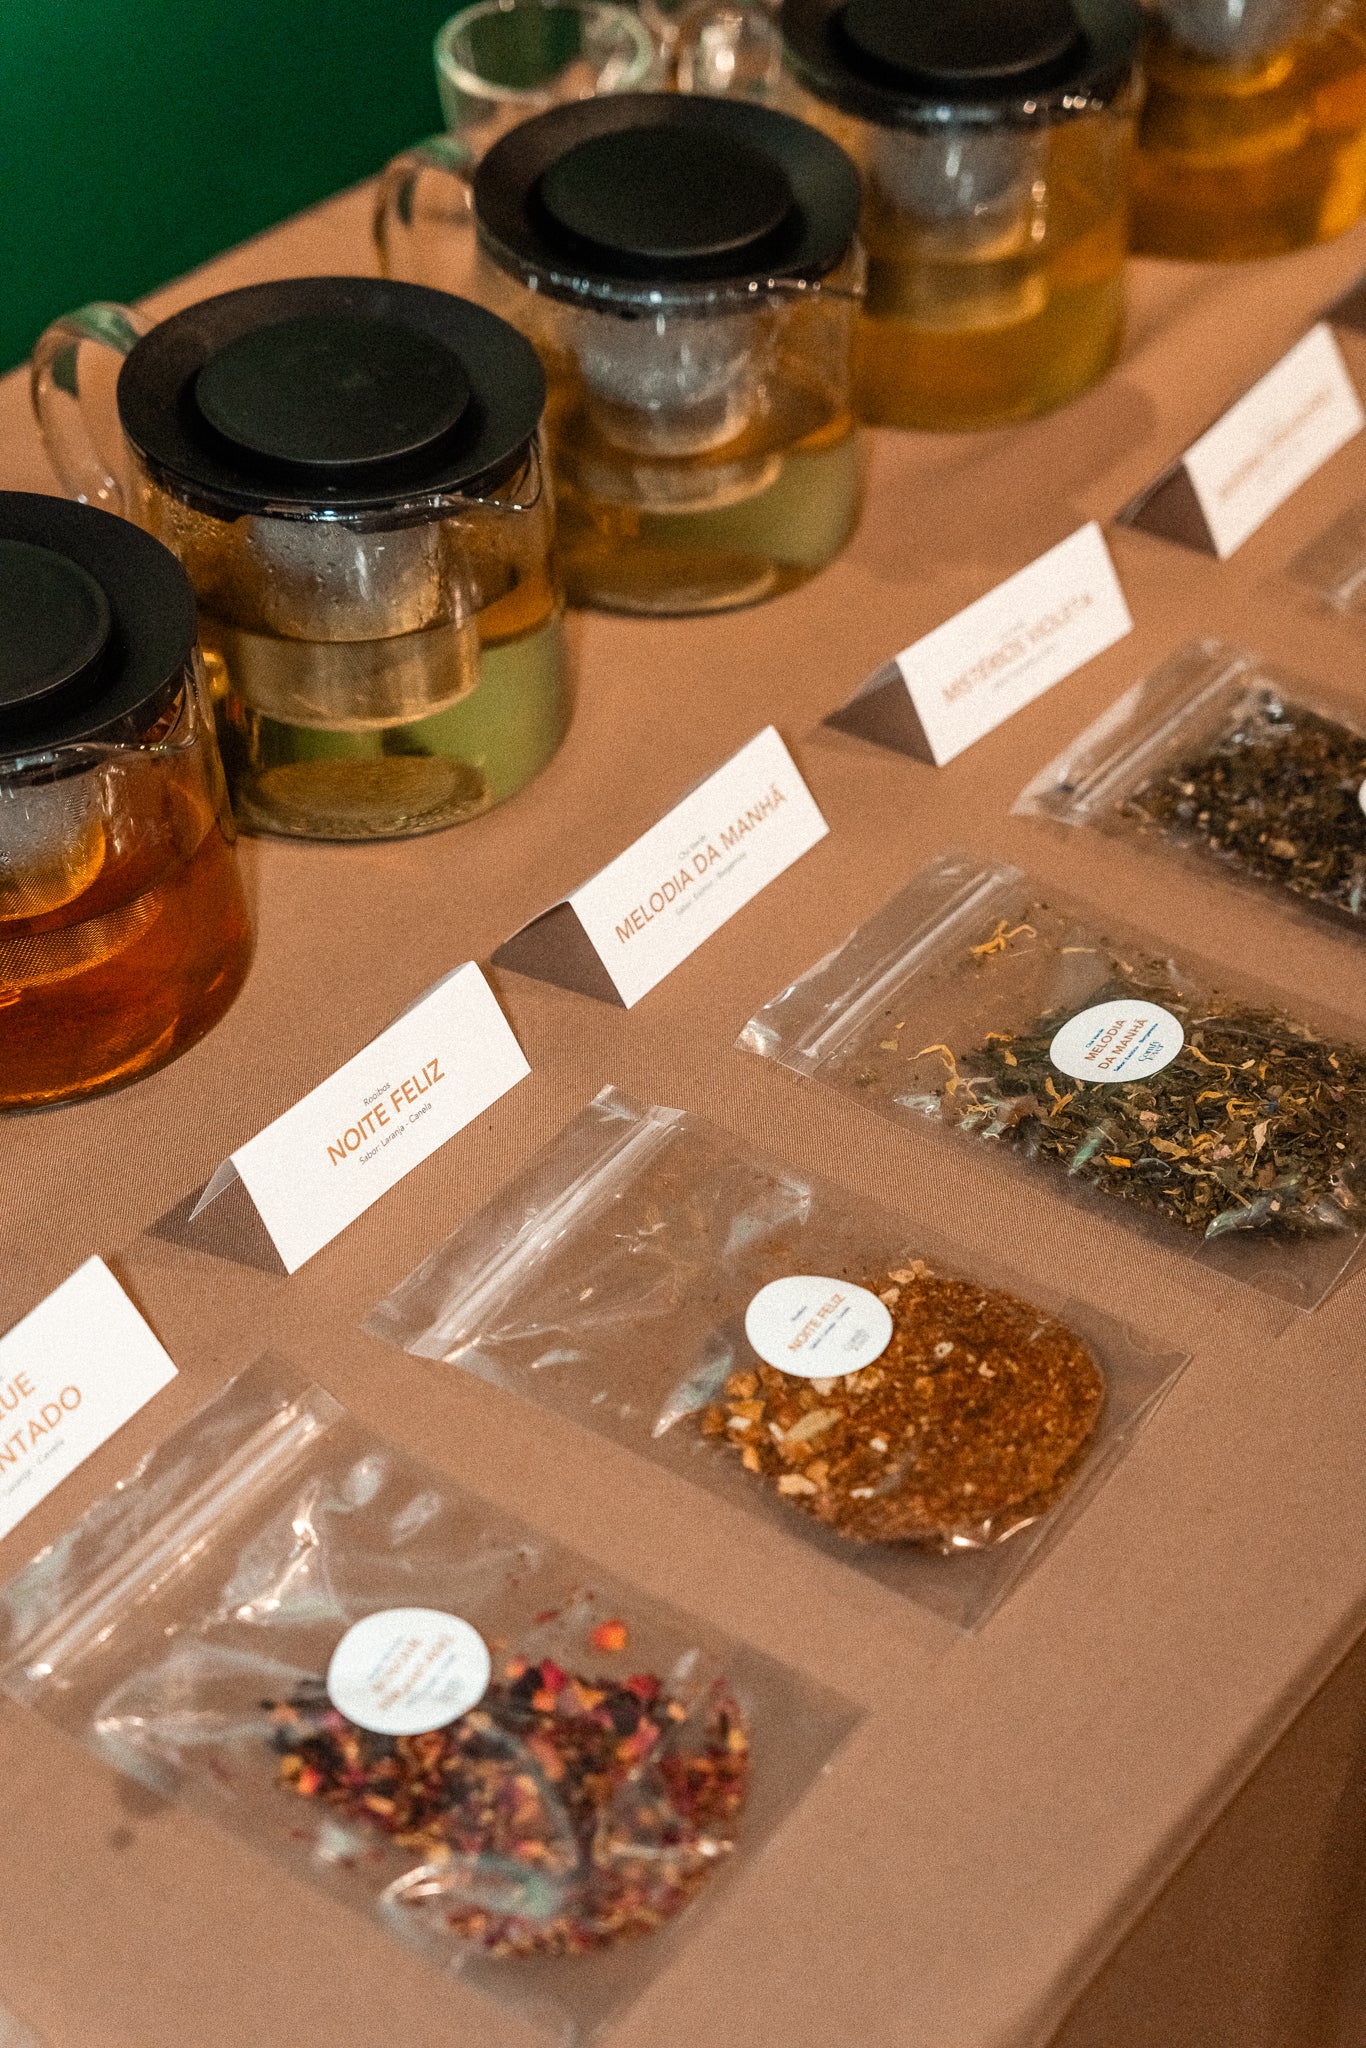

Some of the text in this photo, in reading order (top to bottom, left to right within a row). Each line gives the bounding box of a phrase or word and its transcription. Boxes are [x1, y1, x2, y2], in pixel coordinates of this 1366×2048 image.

[615, 868, 694, 944] MELODIA
[692, 844, 721, 874] DA
[720, 783, 787, 850] MANHÃ
[1084, 1020, 1126, 1061] MELODIA
[1098, 1019, 1147, 1069] DA MANHÃ
[326, 1058, 445, 1166] NOITE FELIZ
[363, 1082, 391, 1106] Rooibos
[359, 1143, 380, 1165] Sabor:
[381, 1124, 405, 1147] Laranja
[408, 1102, 432, 1123] Canela
[0, 1371, 36, 1421] UE
